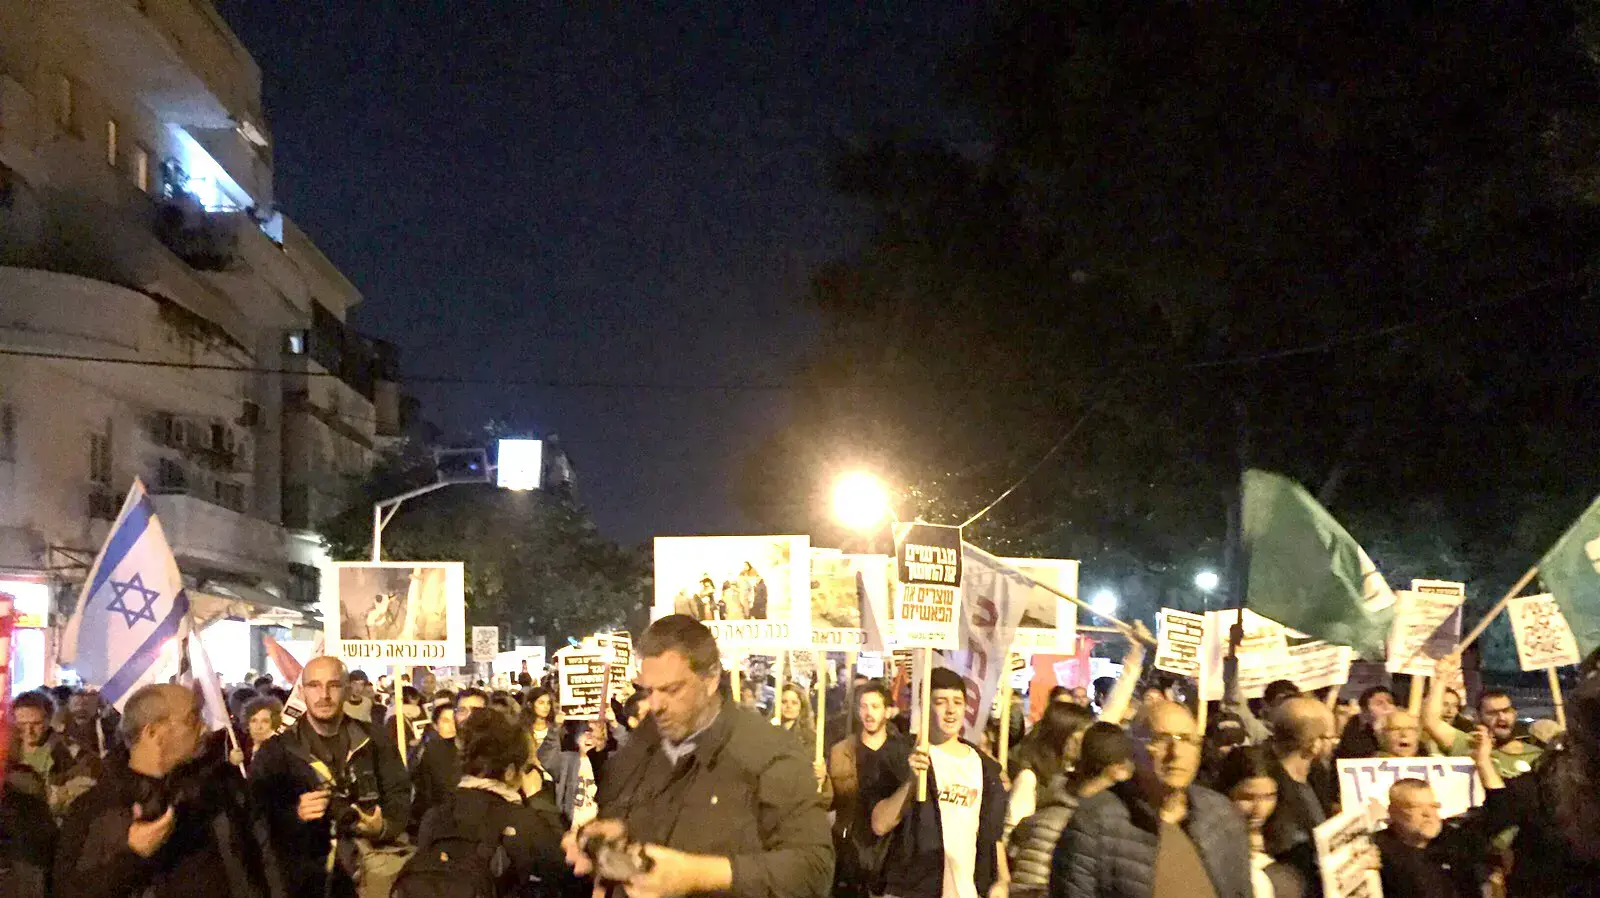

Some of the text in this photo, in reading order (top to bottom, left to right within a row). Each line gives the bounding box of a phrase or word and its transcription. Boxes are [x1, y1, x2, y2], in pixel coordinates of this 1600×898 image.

[905, 544, 957, 566] מגרשים
[903, 586, 954, 606] עוצרים את
[901, 603, 953, 623] הפאשיזם
[724, 624, 759, 641] נראה
[766, 624, 789, 639] ככה
[343, 643, 445, 658] ככה נראה כיבוש!
